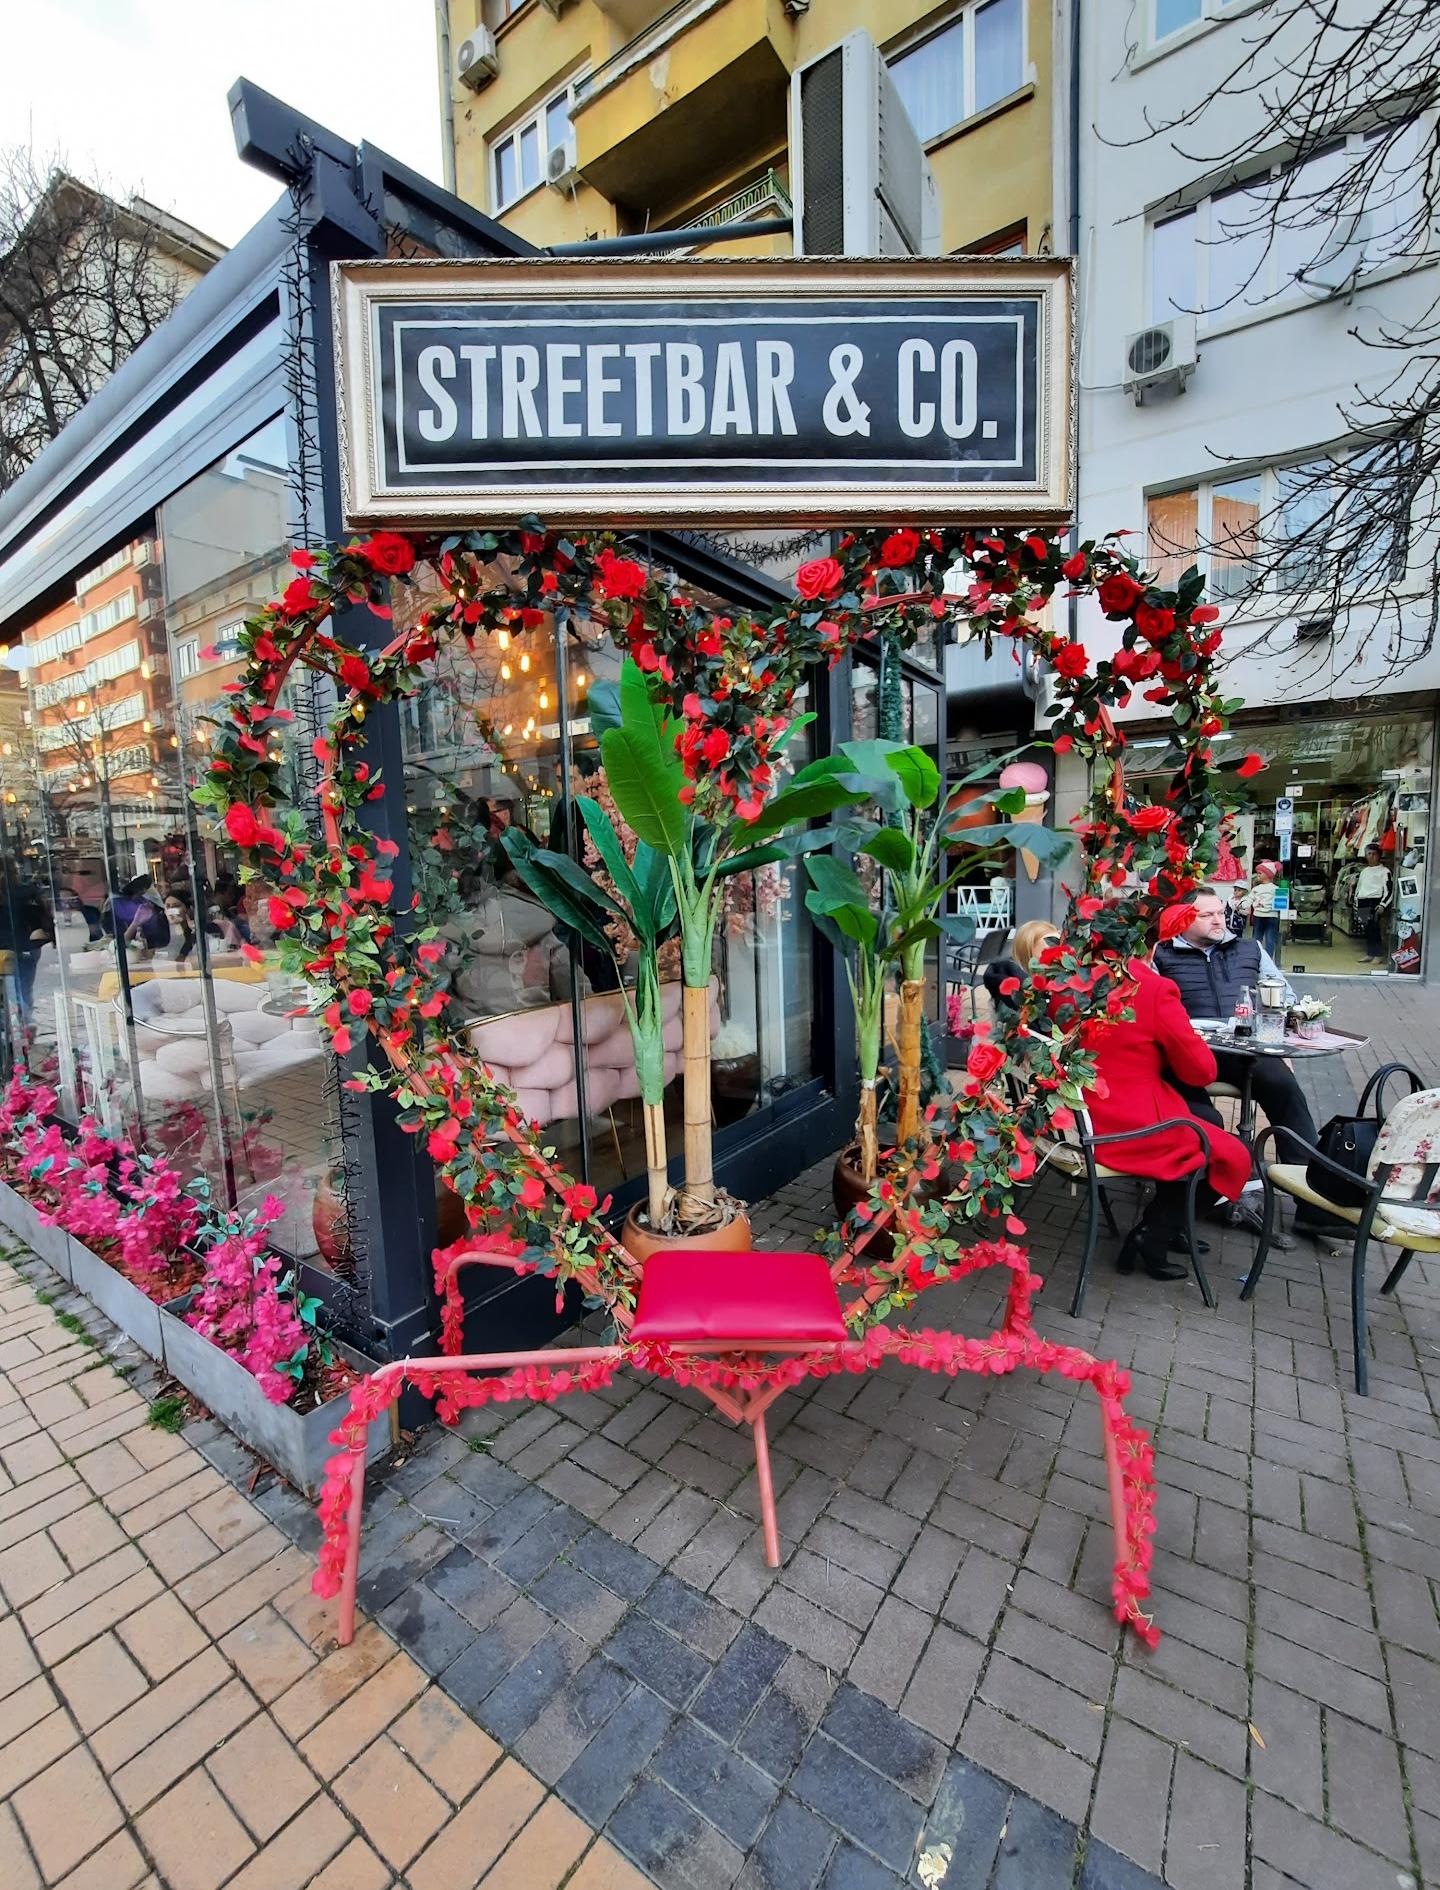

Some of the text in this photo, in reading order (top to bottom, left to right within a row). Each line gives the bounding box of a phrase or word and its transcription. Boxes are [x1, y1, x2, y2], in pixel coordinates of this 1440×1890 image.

[417, 338, 999, 442] STREETBAR & CO.
